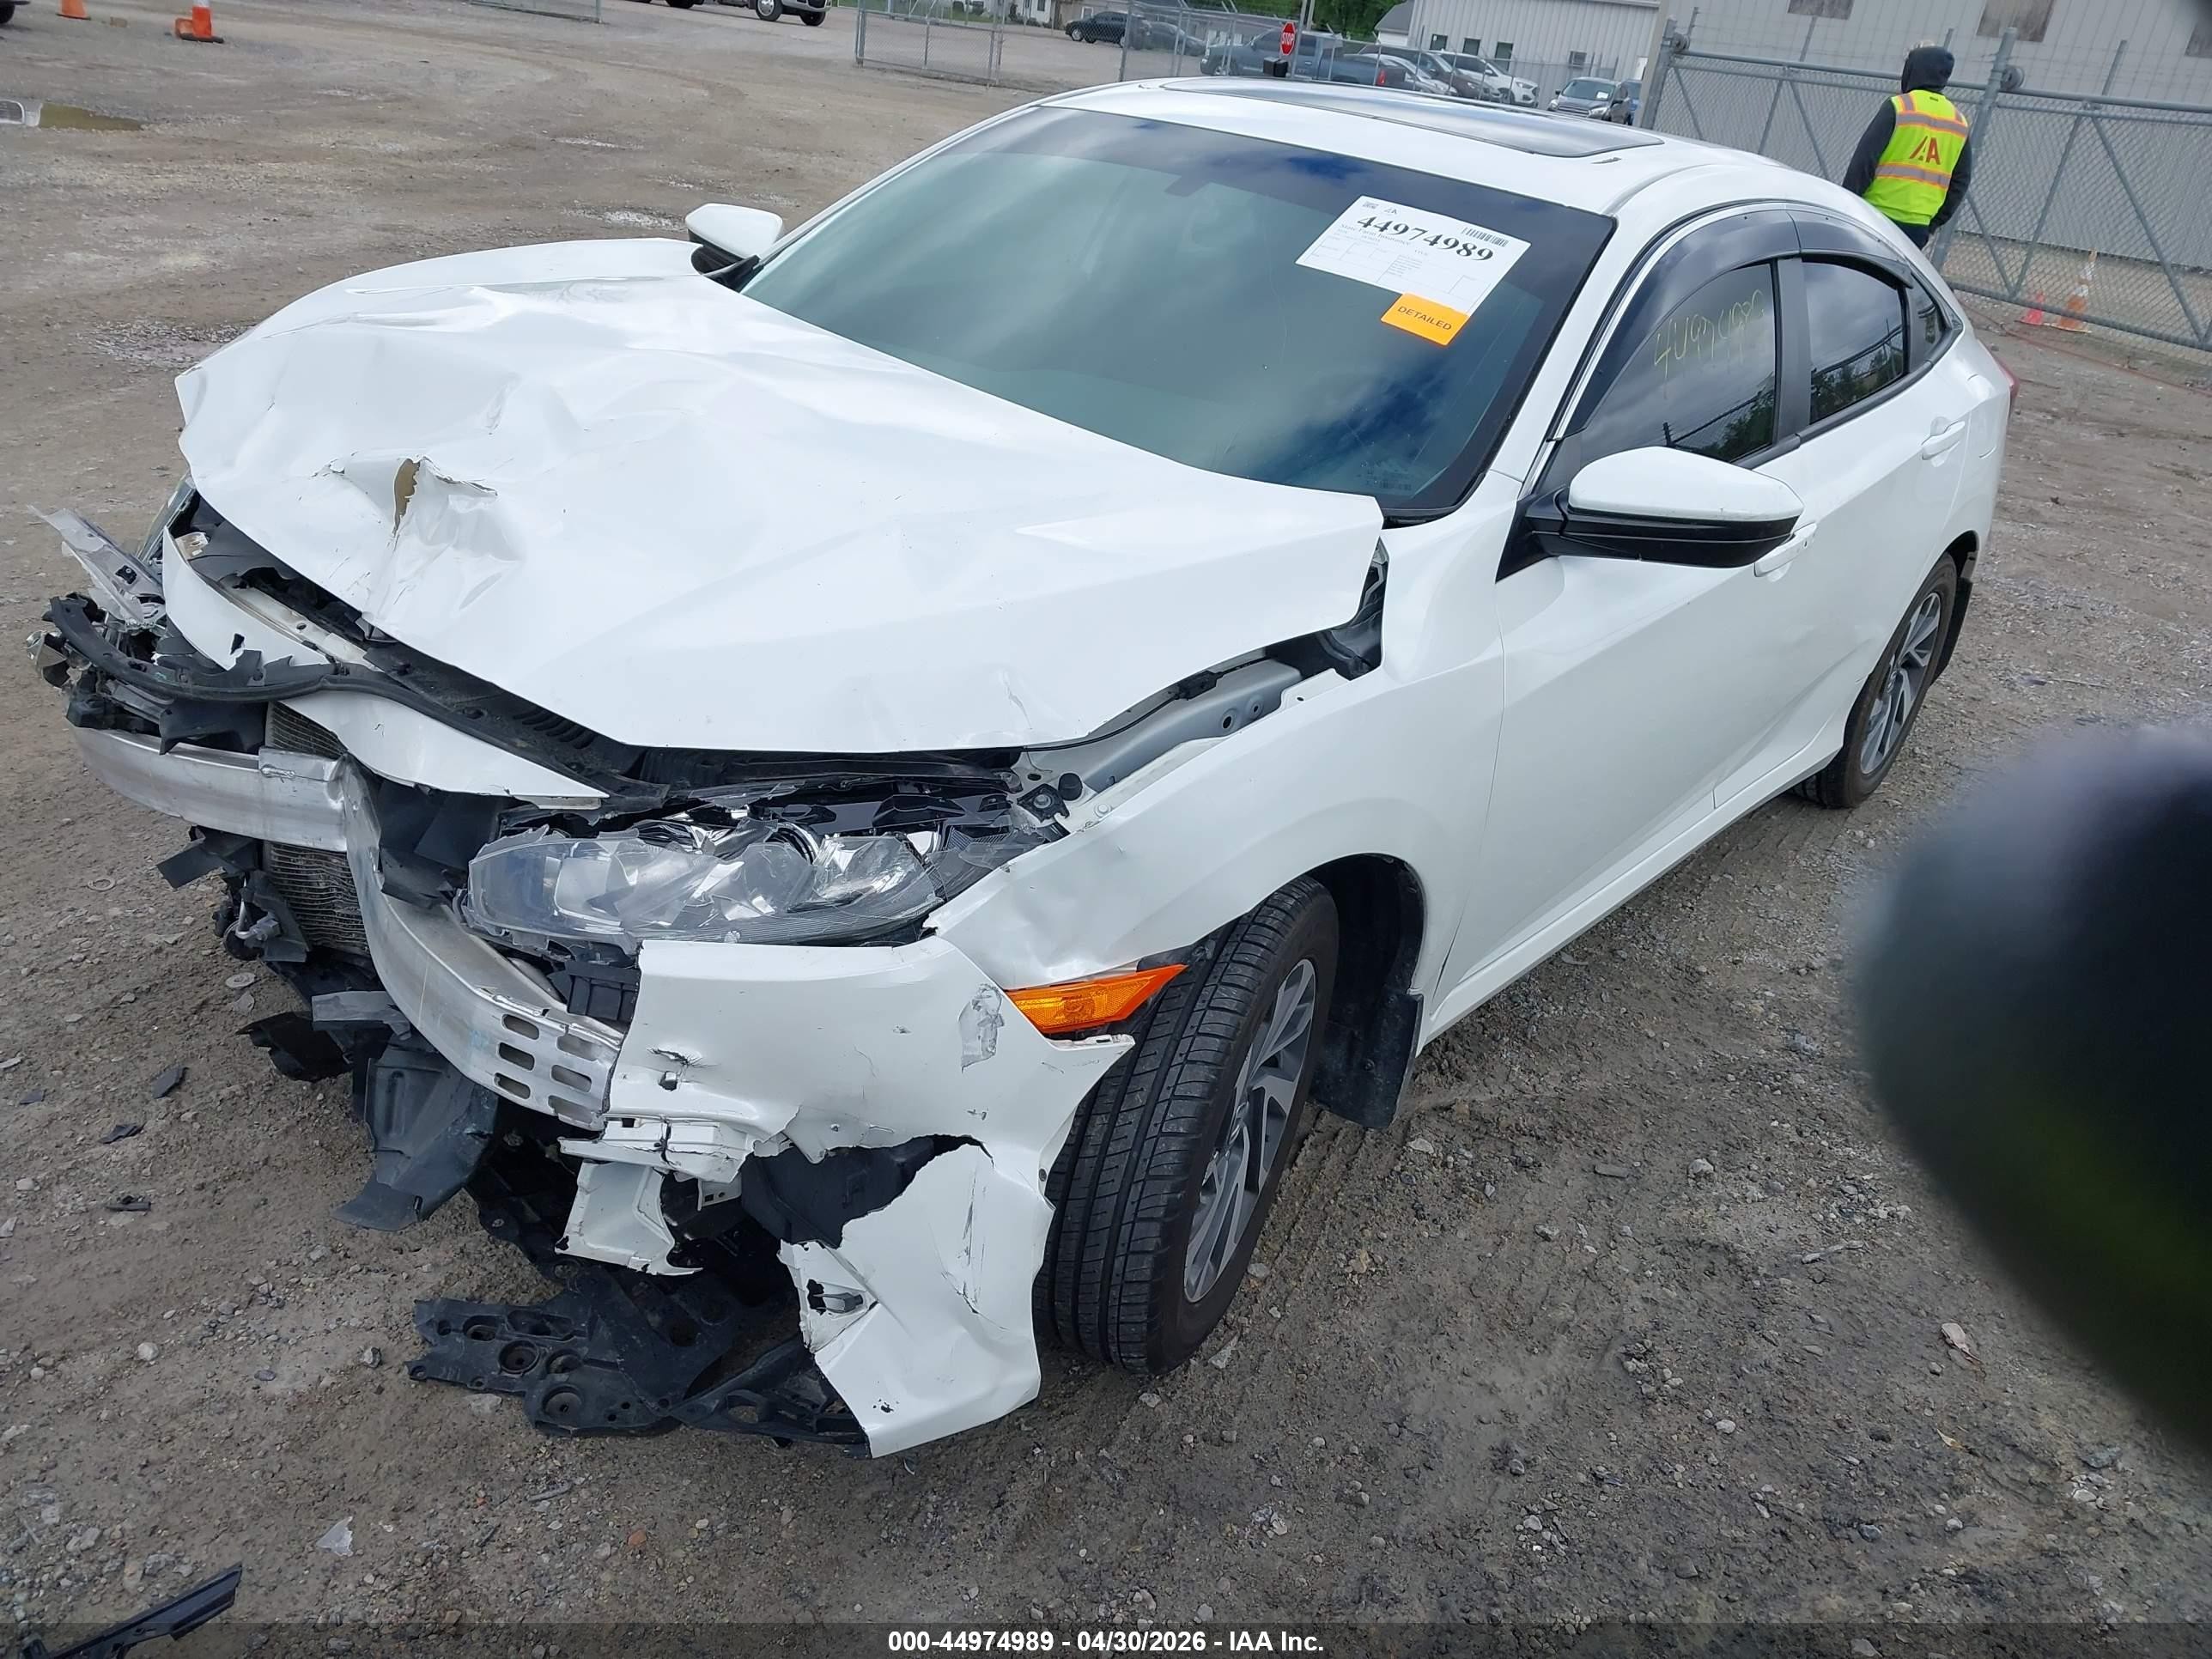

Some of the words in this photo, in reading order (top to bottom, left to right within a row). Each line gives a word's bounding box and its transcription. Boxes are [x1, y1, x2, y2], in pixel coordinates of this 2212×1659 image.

[1282, 32, 1295, 46] STOP
[1357, 216, 1494, 261] 44974989
[1397, 305, 1453, 331] DETAILED
